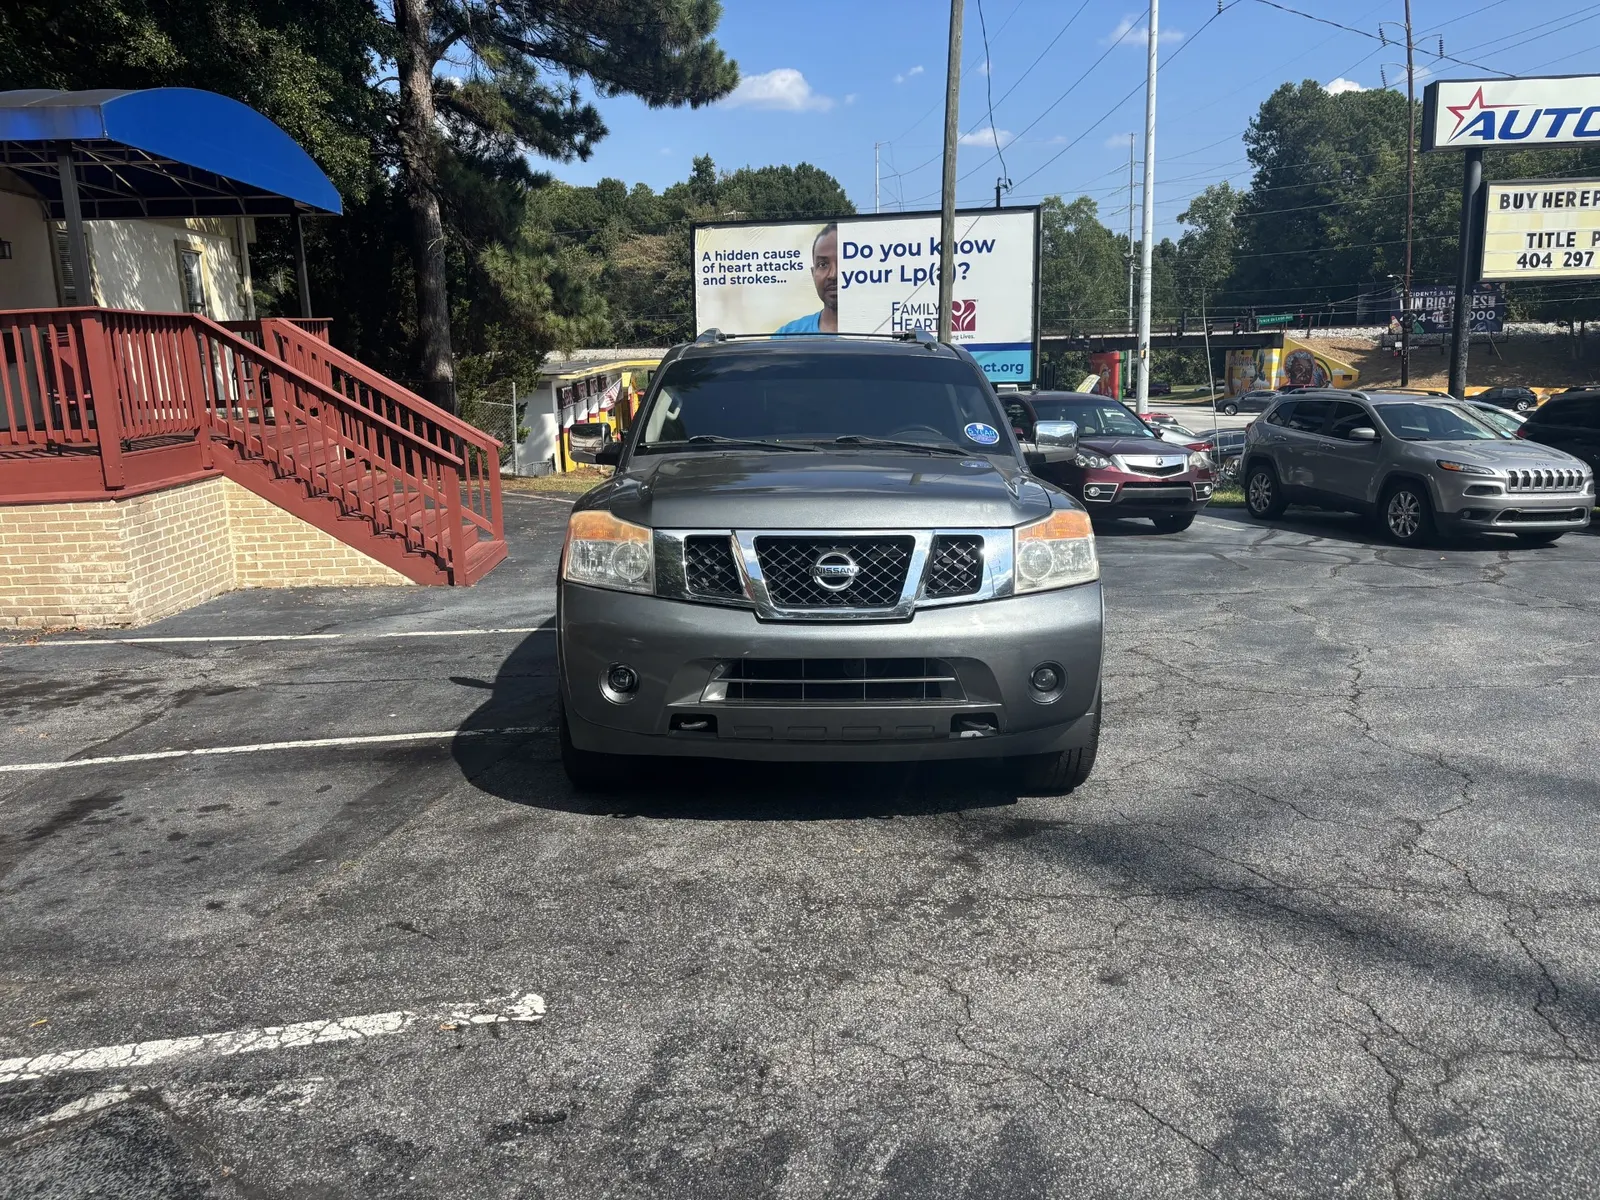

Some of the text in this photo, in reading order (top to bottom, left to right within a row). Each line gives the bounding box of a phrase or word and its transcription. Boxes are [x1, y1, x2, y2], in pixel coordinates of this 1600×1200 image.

[1500, 192, 1538, 209] BUY
[1527, 231, 1576, 248] TITLE
[702, 249, 801, 261] A hidden cause
[842, 241, 873, 259] Do
[879, 242, 921, 262] you
[702, 260, 804, 273] of heart attacks
[1517, 251, 1594, 269] 404 297
[703, 273, 787, 285] and strokes...
[841, 269, 892, 289] your
[892, 301, 939, 316] FAMILY
[1426, 296, 1446, 310] BIG
[892, 316, 939, 331] HEART
